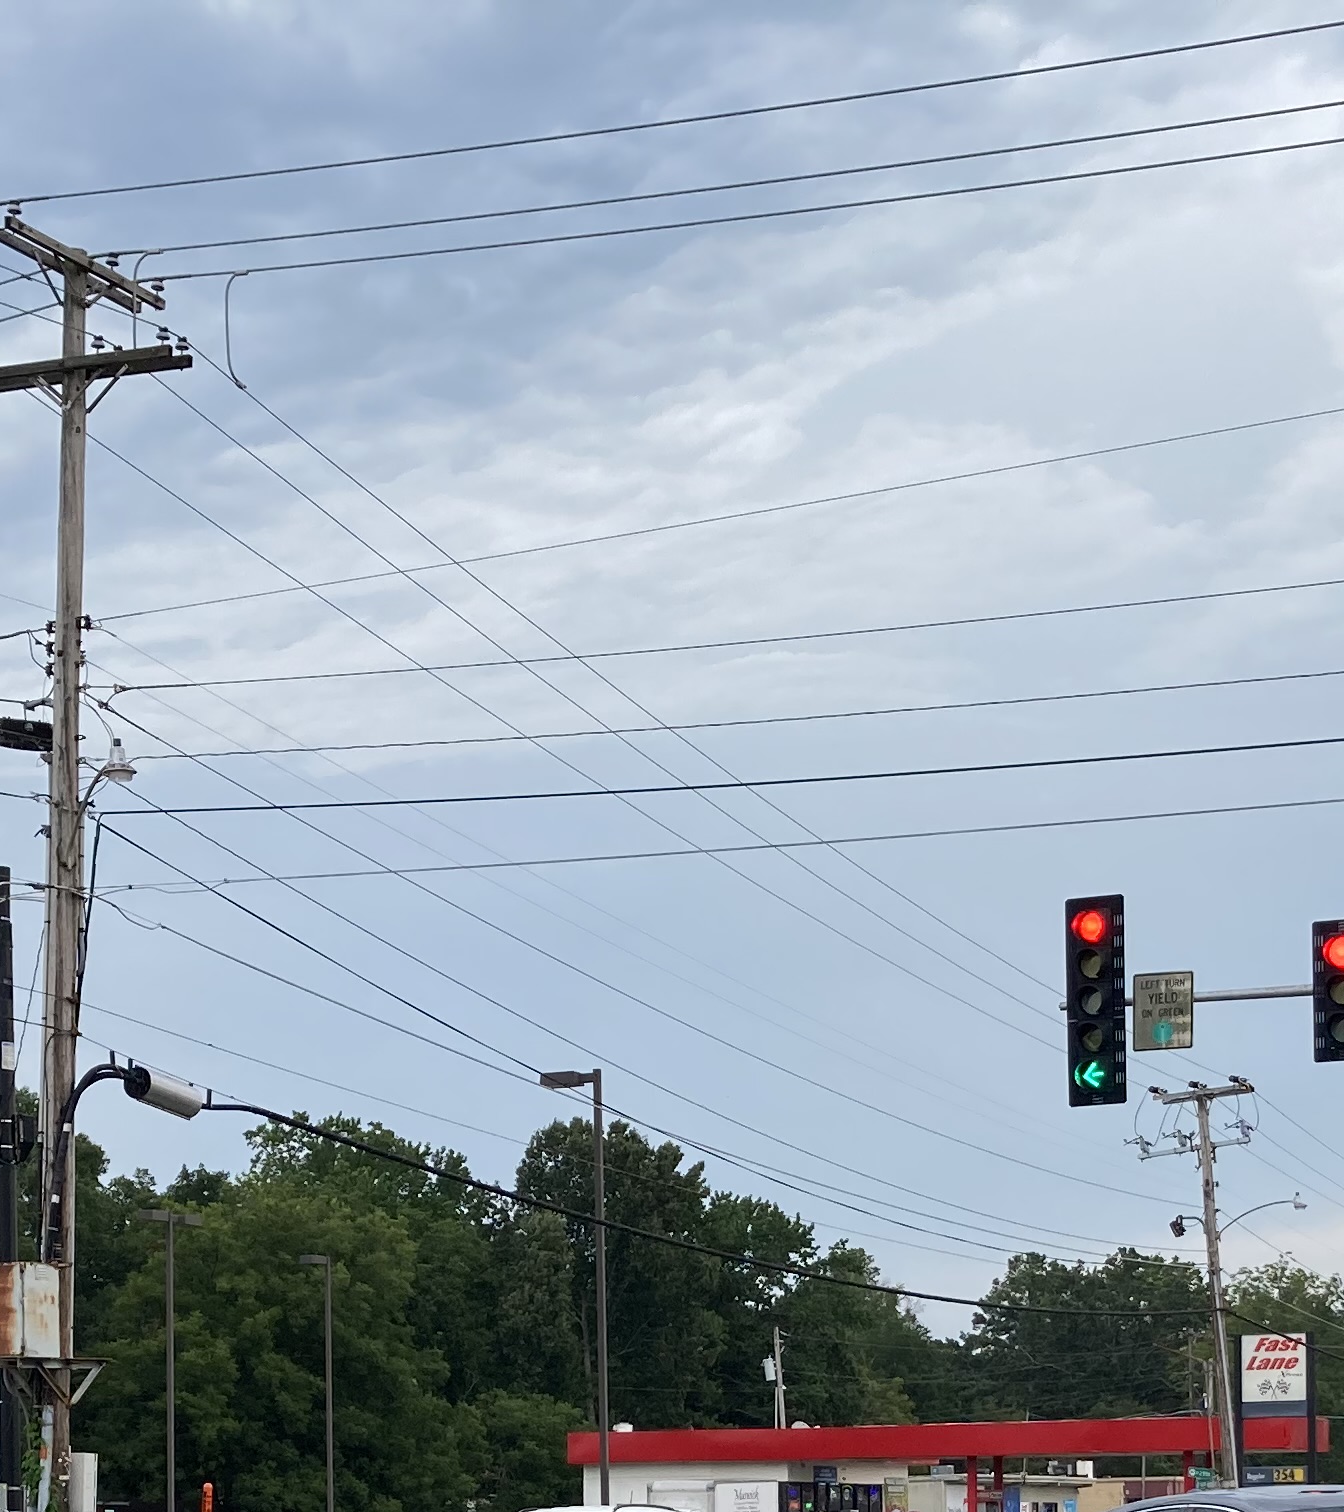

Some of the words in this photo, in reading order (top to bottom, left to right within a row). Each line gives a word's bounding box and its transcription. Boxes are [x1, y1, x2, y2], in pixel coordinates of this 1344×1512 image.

[1141, 980, 1160, 990] LEFT
[1165, 978, 1185, 988] TURN
[1148, 991, 1178, 1005] YIELD
[1142, 1009, 1153, 1018] ON
[1158, 1007, 1184, 1018] GREEN
[1253, 1337, 1302, 1352] Fast
[1245, 1356, 1299, 1371] Lane
[1273, 1470, 1296, 1481] 354
